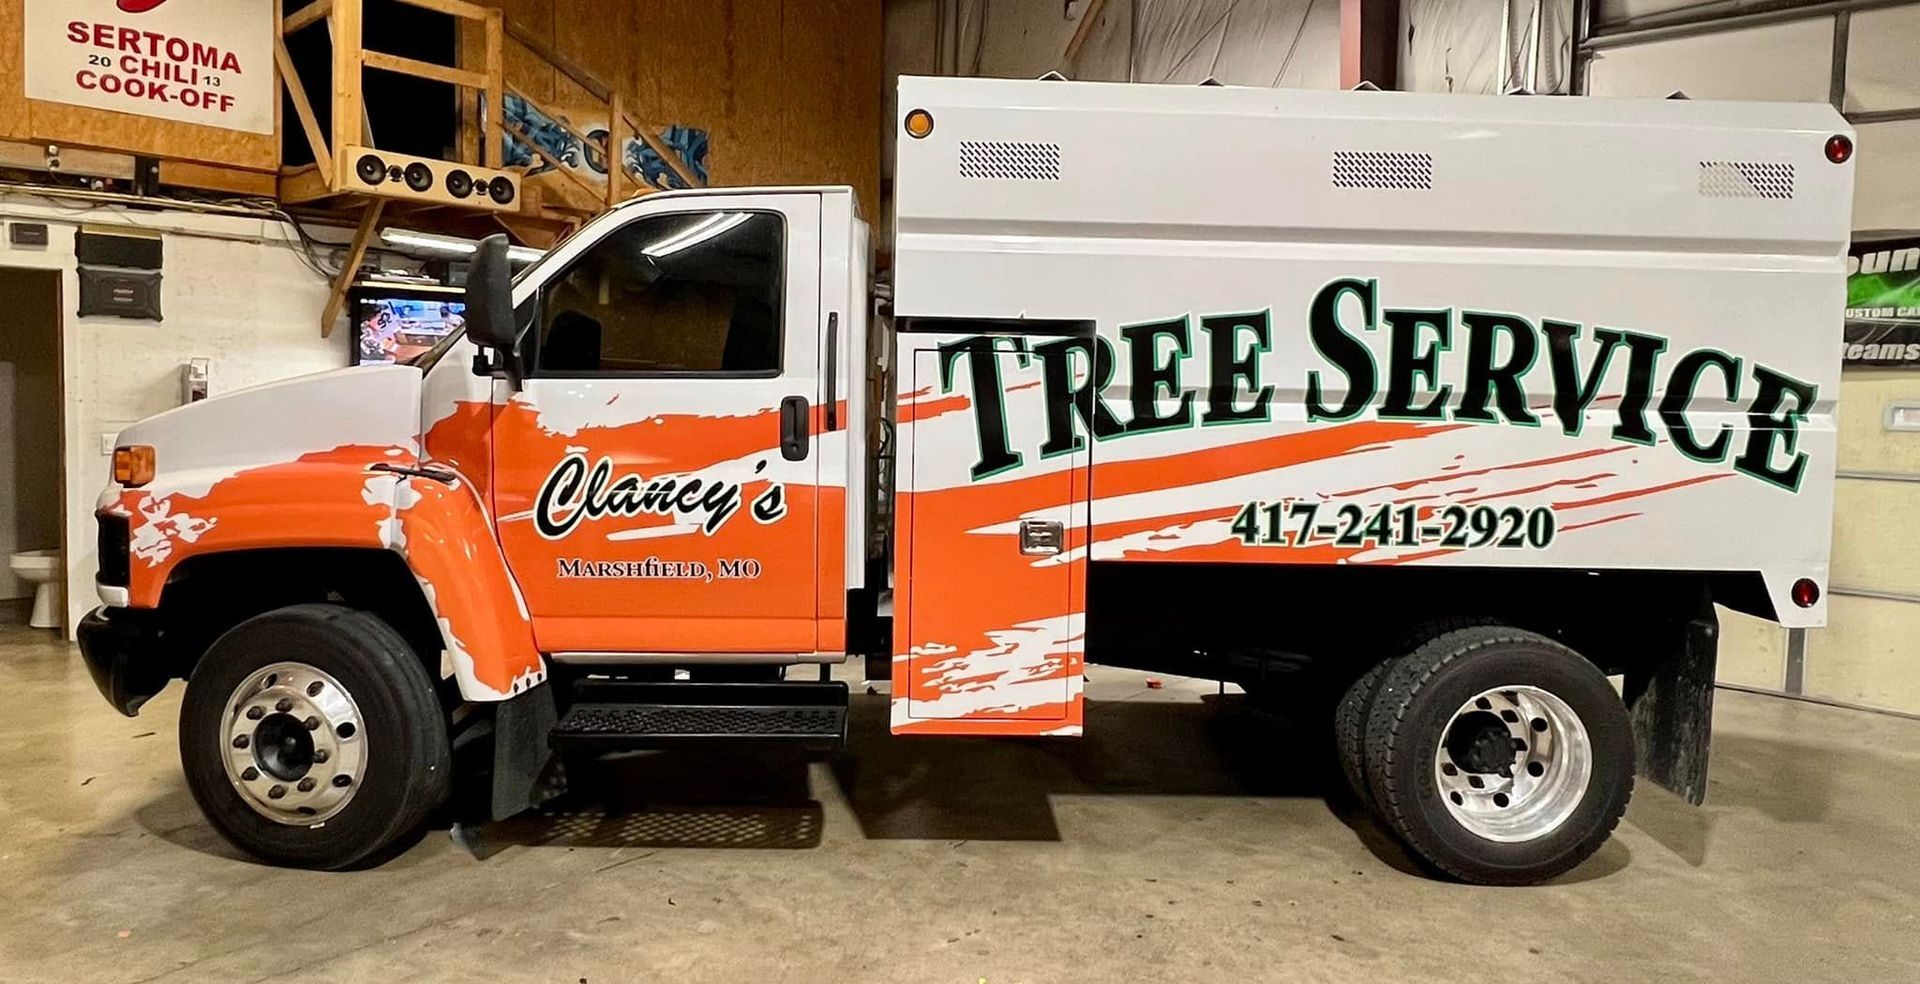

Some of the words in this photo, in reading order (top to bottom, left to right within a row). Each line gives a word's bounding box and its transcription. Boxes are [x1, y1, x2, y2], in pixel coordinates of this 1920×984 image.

[67, 21, 242, 74] SERTOMA
[88, 54, 112, 68] 20
[119, 55, 198, 86] CHILI
[203, 75, 221, 87] 13
[75, 69, 236, 113] COOK-OFF
[937, 308, 1275, 482] TREE
[1306, 276, 1820, 494] SERVICE
[534, 453, 787, 540] Clancy's
[1231, 501, 1556, 549] 417-241-2920
[717, 558, 761, 579] MO
